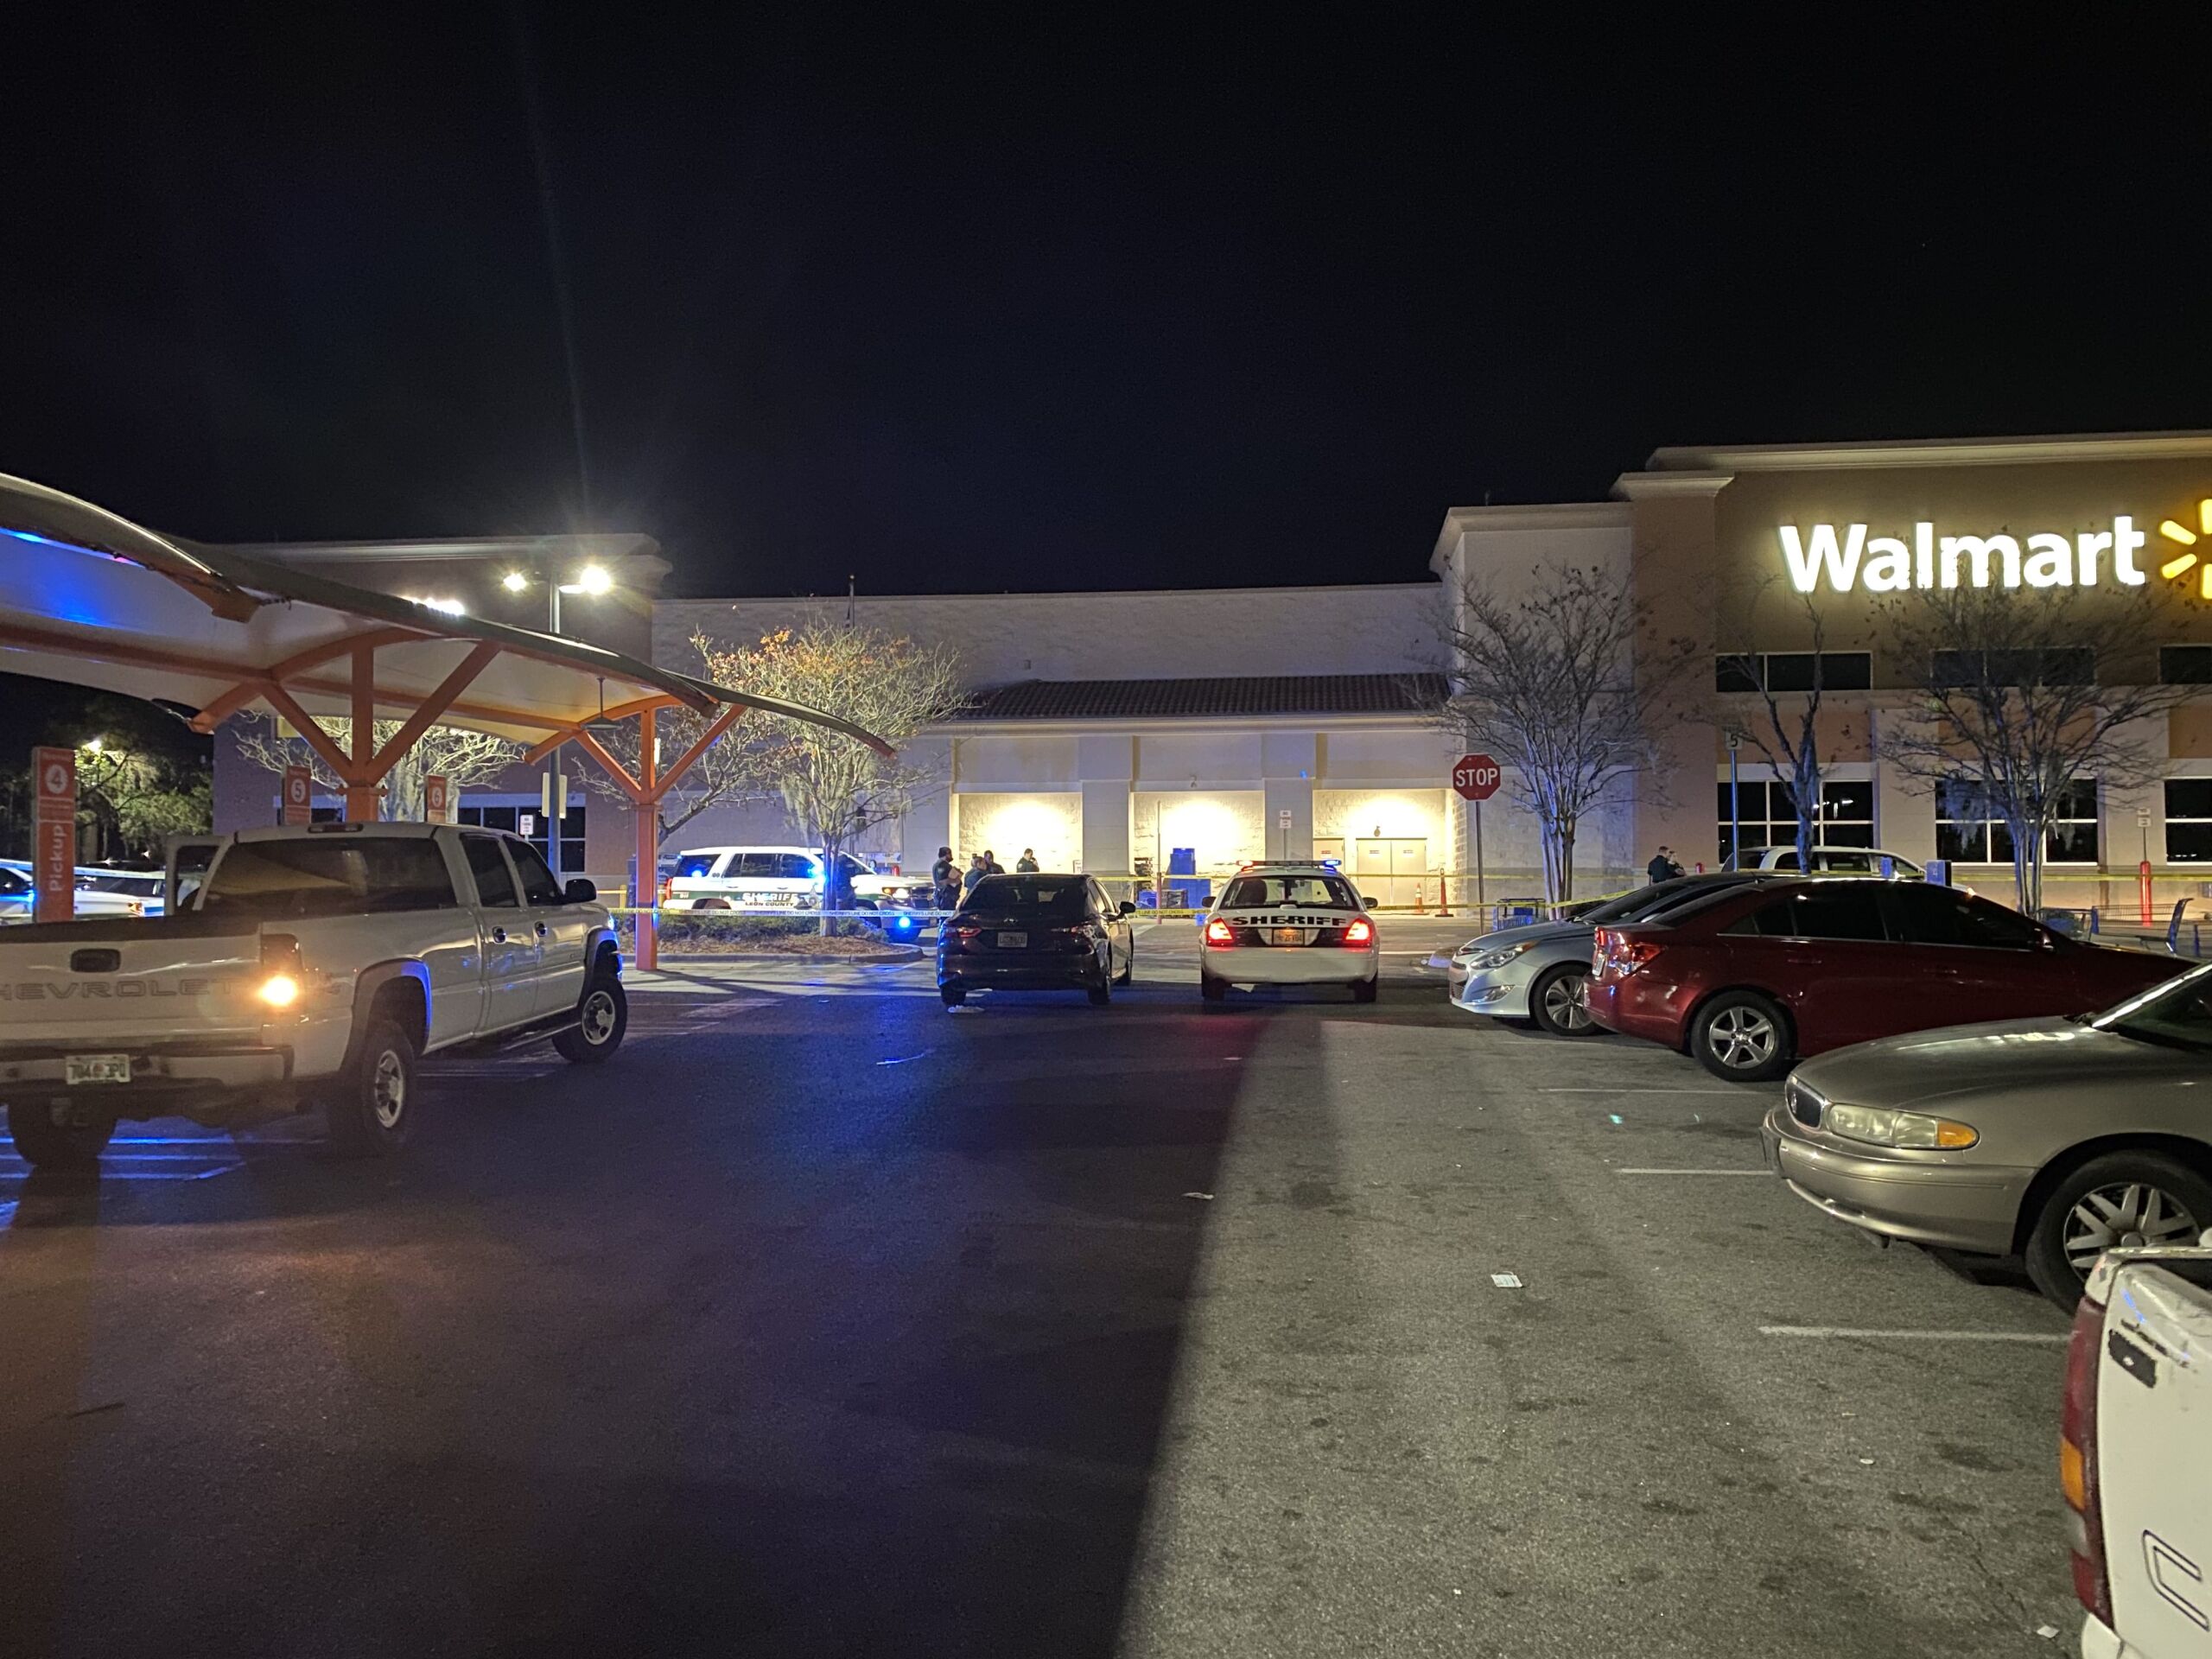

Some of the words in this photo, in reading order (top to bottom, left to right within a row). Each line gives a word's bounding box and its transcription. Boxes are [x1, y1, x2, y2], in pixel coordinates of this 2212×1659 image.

[1779, 515, 2145, 593] Walmart
[48, 768, 63, 789] 4
[1455, 767, 1498, 787] STOP
[49, 824, 67, 891] Pickup
[742, 892, 798, 902] SHERIFF
[1232, 916, 1346, 926] SHERIFF
